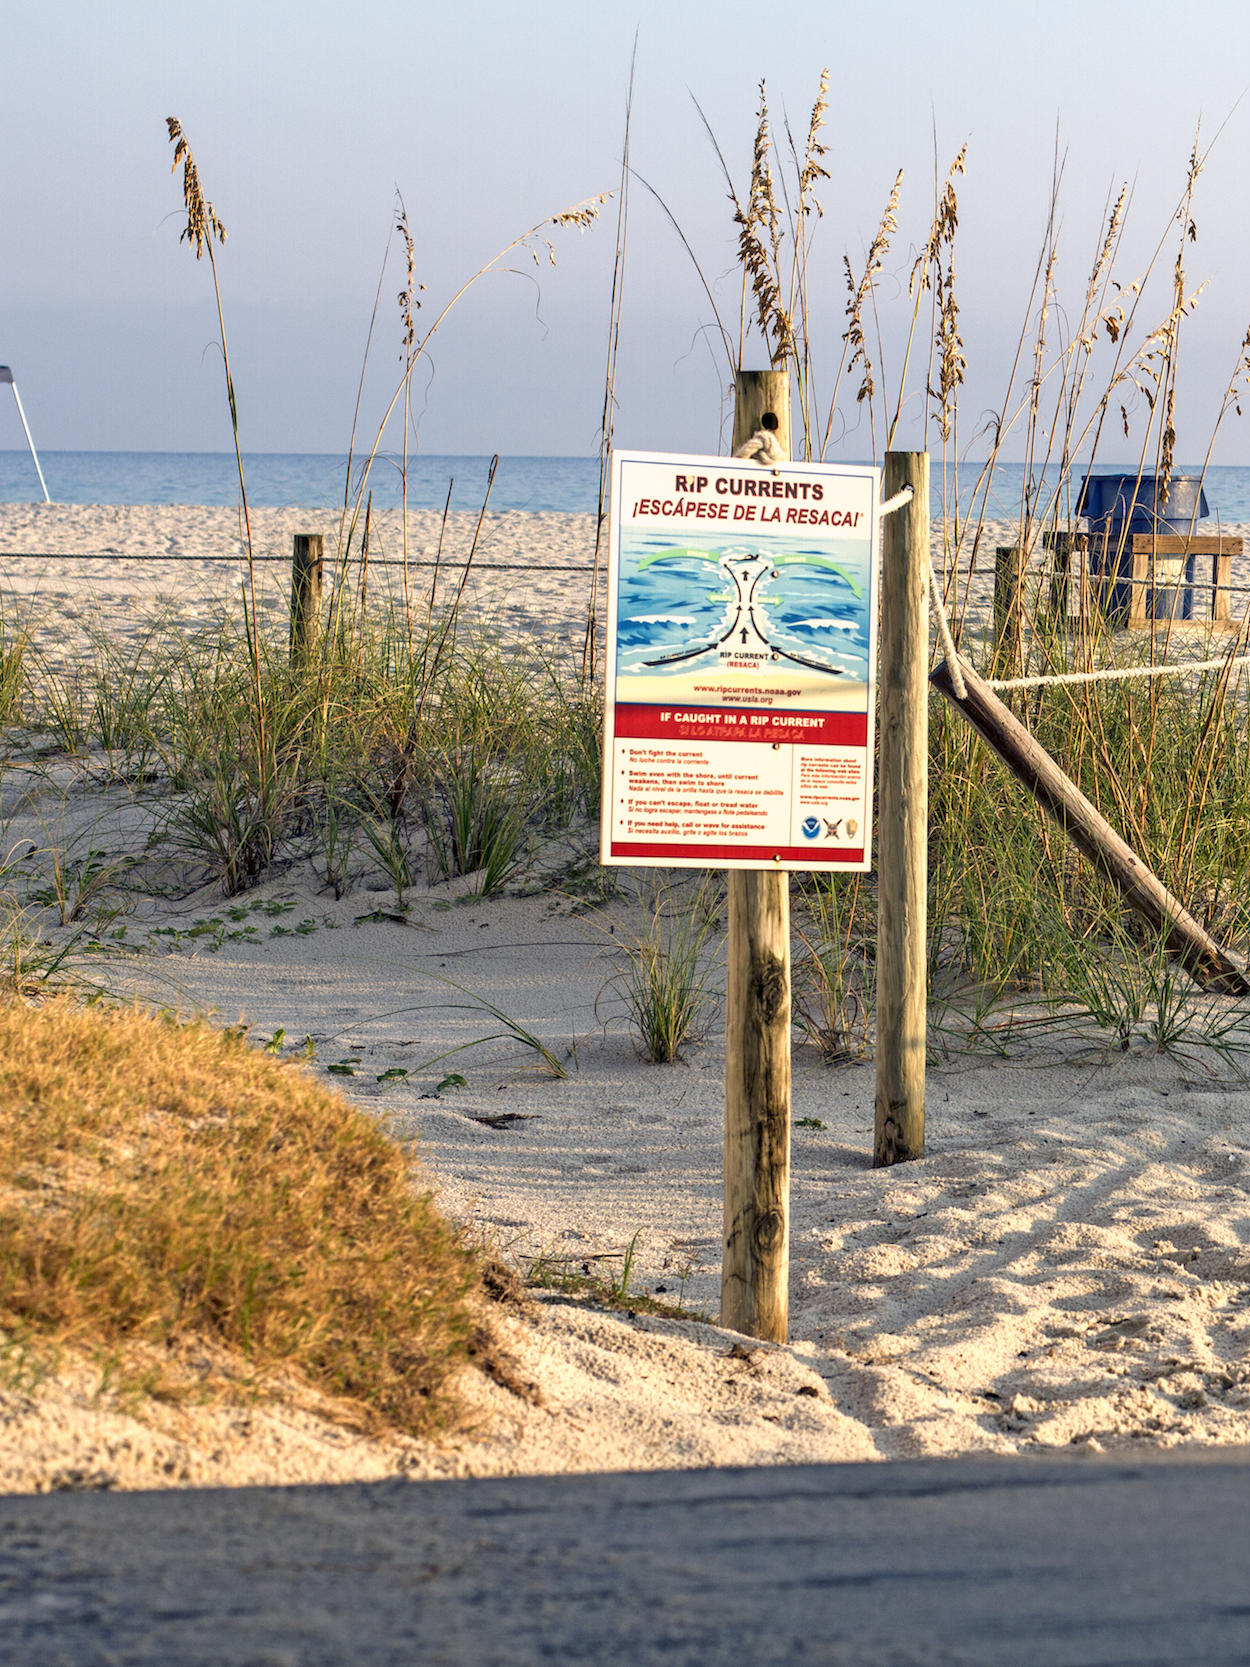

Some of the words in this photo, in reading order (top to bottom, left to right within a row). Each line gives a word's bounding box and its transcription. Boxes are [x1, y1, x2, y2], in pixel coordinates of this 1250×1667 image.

[676, 475, 708, 493] RIP
[715, 478, 824, 500] CURRENTS
[632, 498, 729, 519] ¡ESCÁPESE
[734, 505, 754, 521] DE
[760, 506, 781, 522] LA
[786, 508, 860, 527] RESACA!
[720, 651, 732, 660] RIP
[734, 652, 769, 661] CURRENT
[727, 661, 759, 669] (RESACA)
[694, 684, 801, 696] www.ripcurrents.noaa.gov
[722, 695, 773, 704] www.usla.org
[660, 713, 672, 722] IF
[674, 713, 722, 724] CAUGHT
[724, 714, 736, 724] IN
[739, 716, 749, 725] A
[751, 716, 769, 726] RIP
[772, 717, 825, 728] CURRENT
